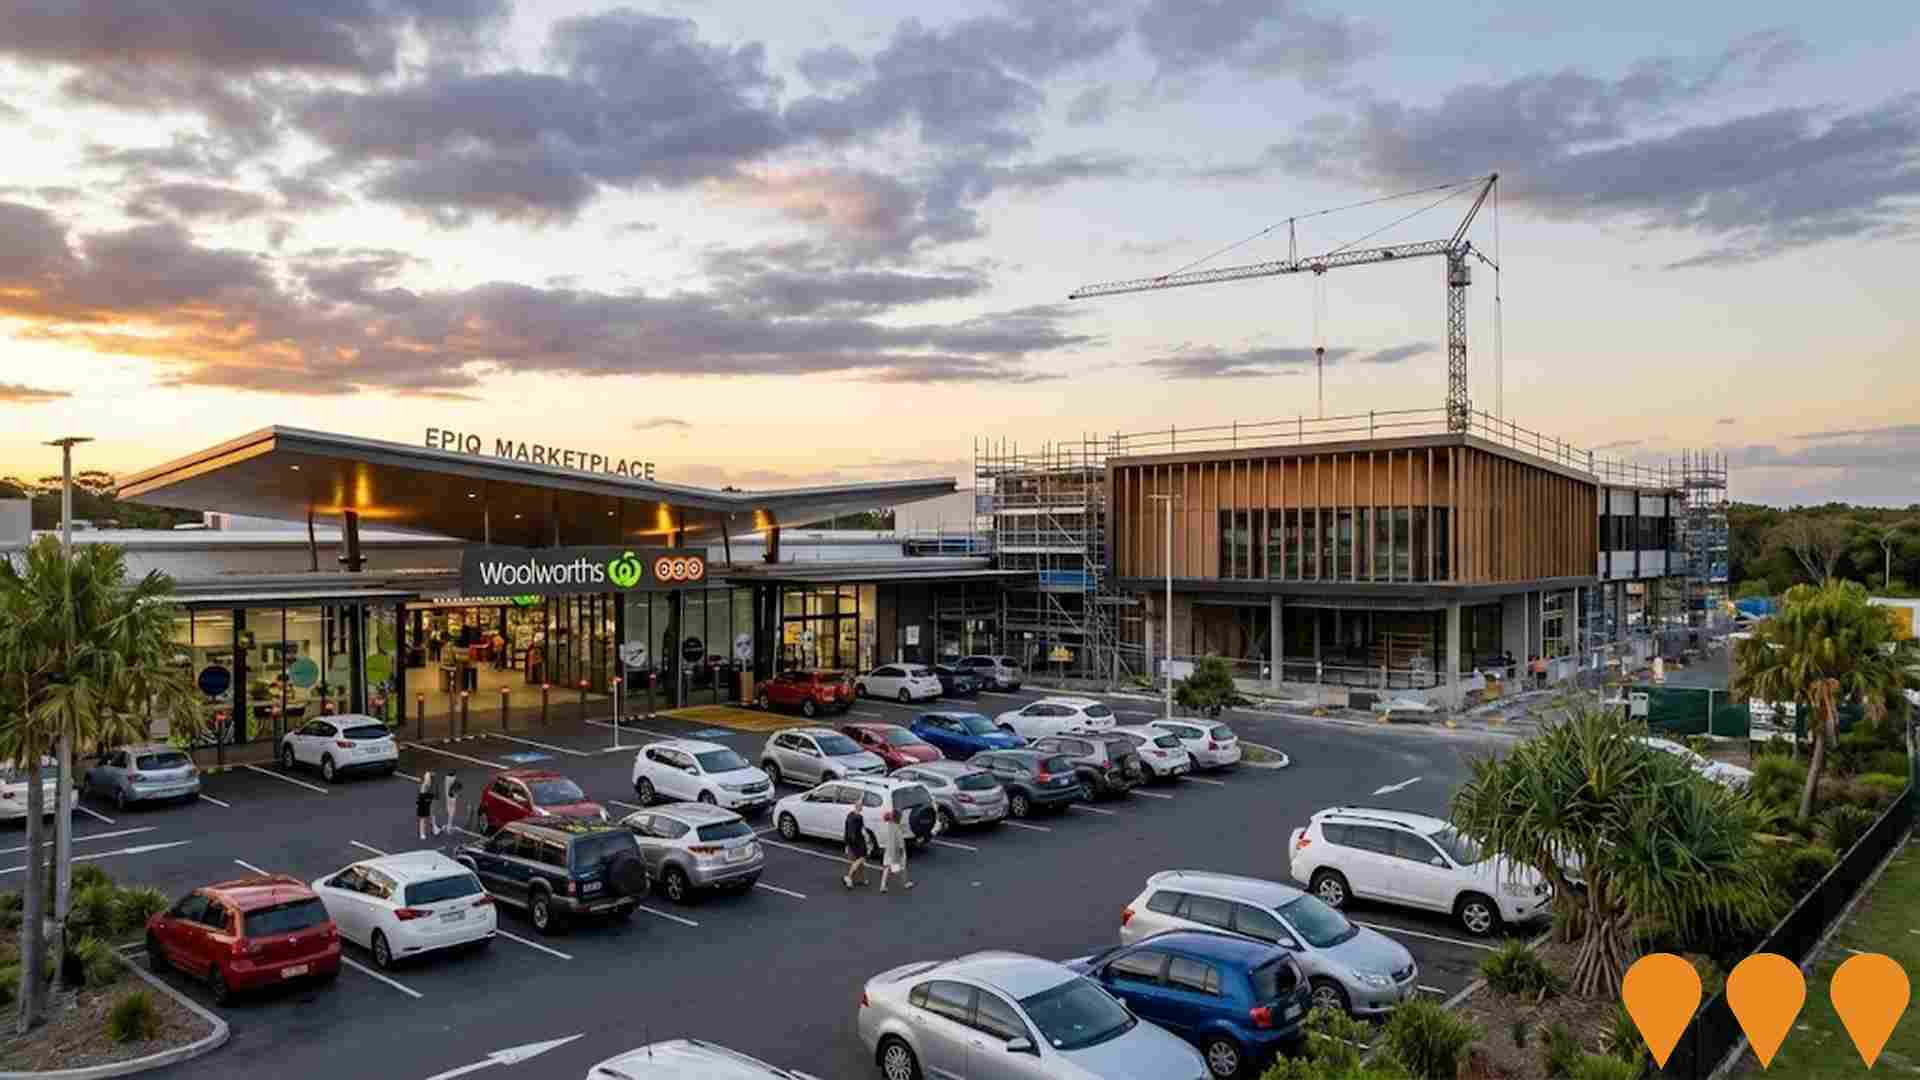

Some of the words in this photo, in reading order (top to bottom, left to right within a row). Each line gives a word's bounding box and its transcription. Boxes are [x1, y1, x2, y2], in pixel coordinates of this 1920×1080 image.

[425, 428, 482, 455] EPIQ
[495, 438, 656, 480] MARKETPLACE
[479, 558, 605, 585] Woolworths
